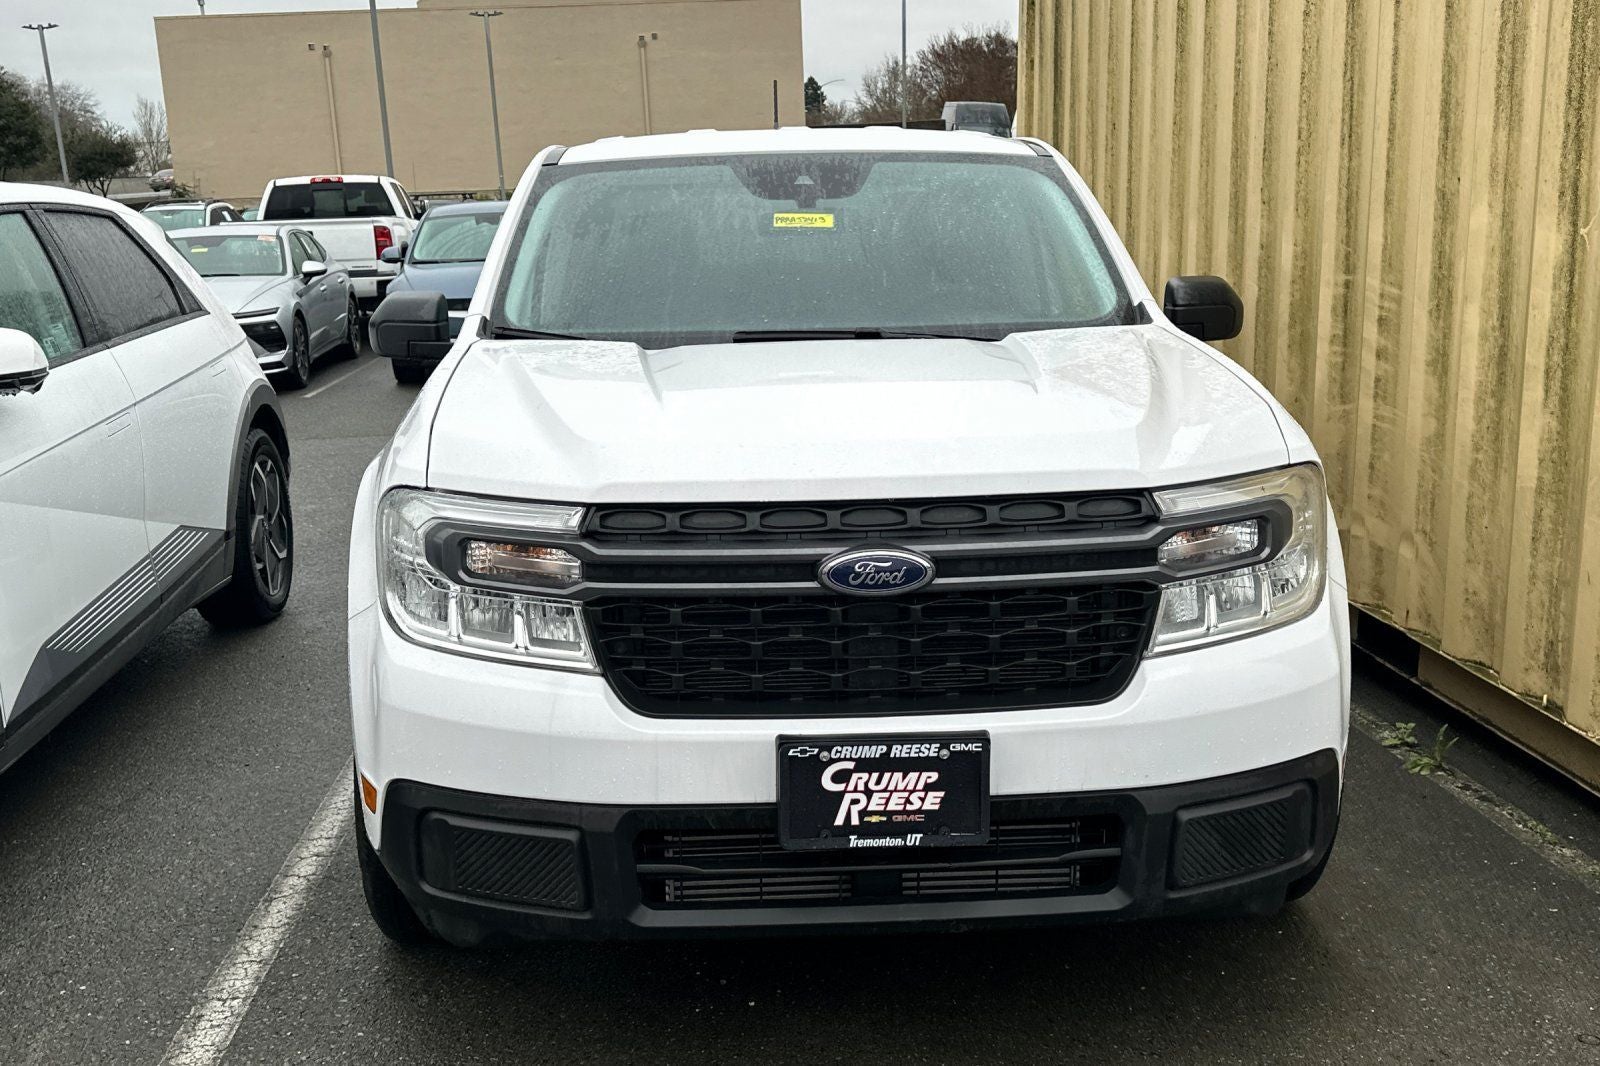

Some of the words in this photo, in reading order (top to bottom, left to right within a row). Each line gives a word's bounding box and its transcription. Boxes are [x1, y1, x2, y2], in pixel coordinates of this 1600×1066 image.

[848, 561, 907, 585] Ford
[830, 745, 886, 759] CRUMP
[890, 743, 940, 758] REESE
[950, 743, 983, 751] GMC
[821, 761, 939, 792] CRUMP
[833, 791, 946, 826] REESE
[892, 814, 925, 822] GMC
[906, 833, 923, 846] UT
